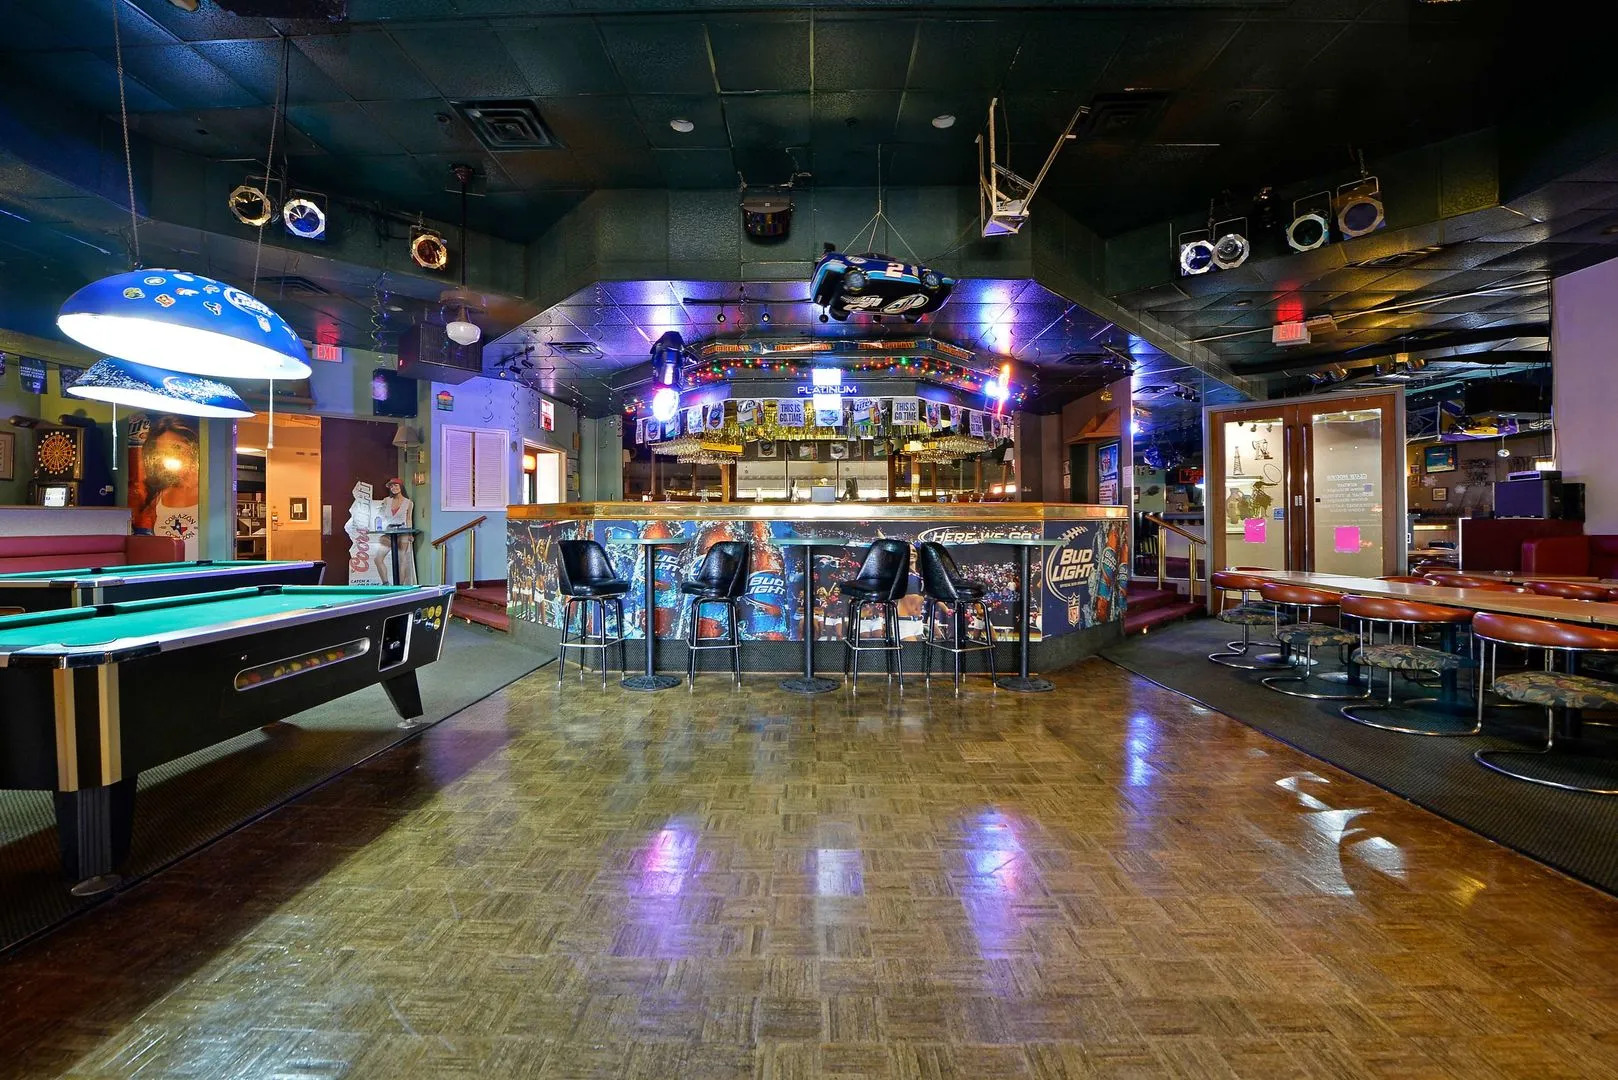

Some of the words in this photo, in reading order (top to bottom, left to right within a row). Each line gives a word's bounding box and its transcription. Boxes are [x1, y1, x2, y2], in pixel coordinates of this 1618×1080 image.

[885, 262, 905, 278] 2
[1279, 324, 1301, 339] EXIT
[317, 345, 337, 360] EXIT
[797, 385, 857, 394] PLATINUM
[780, 403, 793, 413] THIS
[794, 403, 801, 413] IS
[895, 402, 909, 411] THIS
[909, 402, 916, 411] IS
[779, 413, 788, 423] GO
[788, 413, 802, 423] TIME
[894, 411, 903, 421] GO
[903, 411, 917, 421] TIME
[932, 532, 977, 542] HERE
[350, 528, 370, 573] Coors
[1060, 549, 1092, 565] BUD
[1051, 563, 1094, 582] LIGHT
[749, 576, 784, 587] BUD
